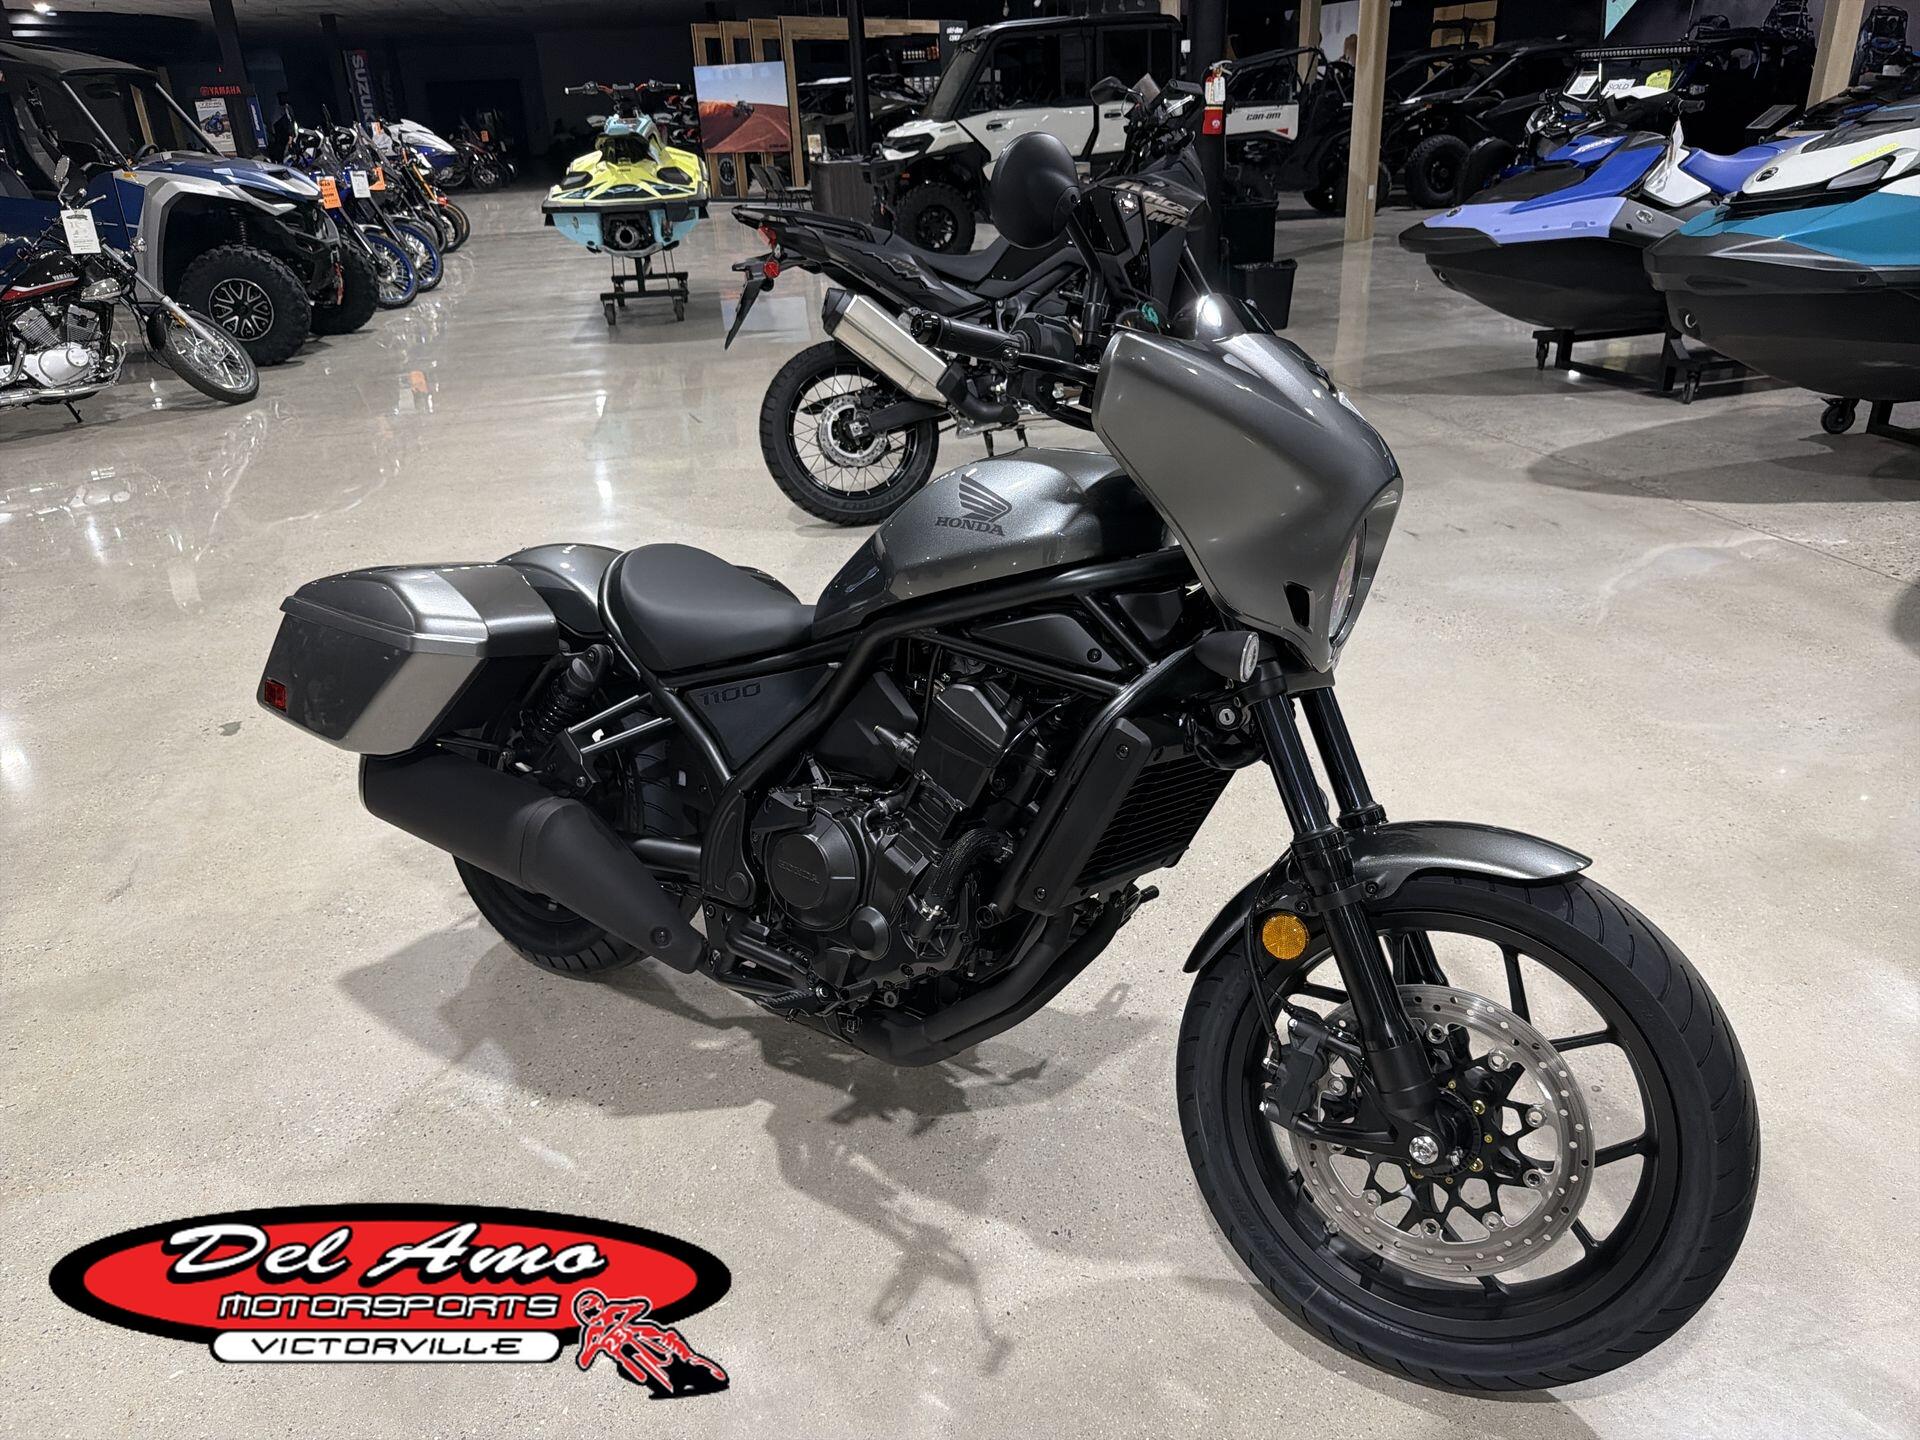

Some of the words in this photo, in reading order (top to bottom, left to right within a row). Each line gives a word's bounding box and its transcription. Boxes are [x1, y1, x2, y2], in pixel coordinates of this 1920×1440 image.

[208, 86, 242, 95] YAMAHA
[352, 54, 376, 121] SUZUK
[1607, 82, 1630, 91] SOLD
[934, 516, 1006, 537] HONDA
[700, 682, 761, 705] 1100
